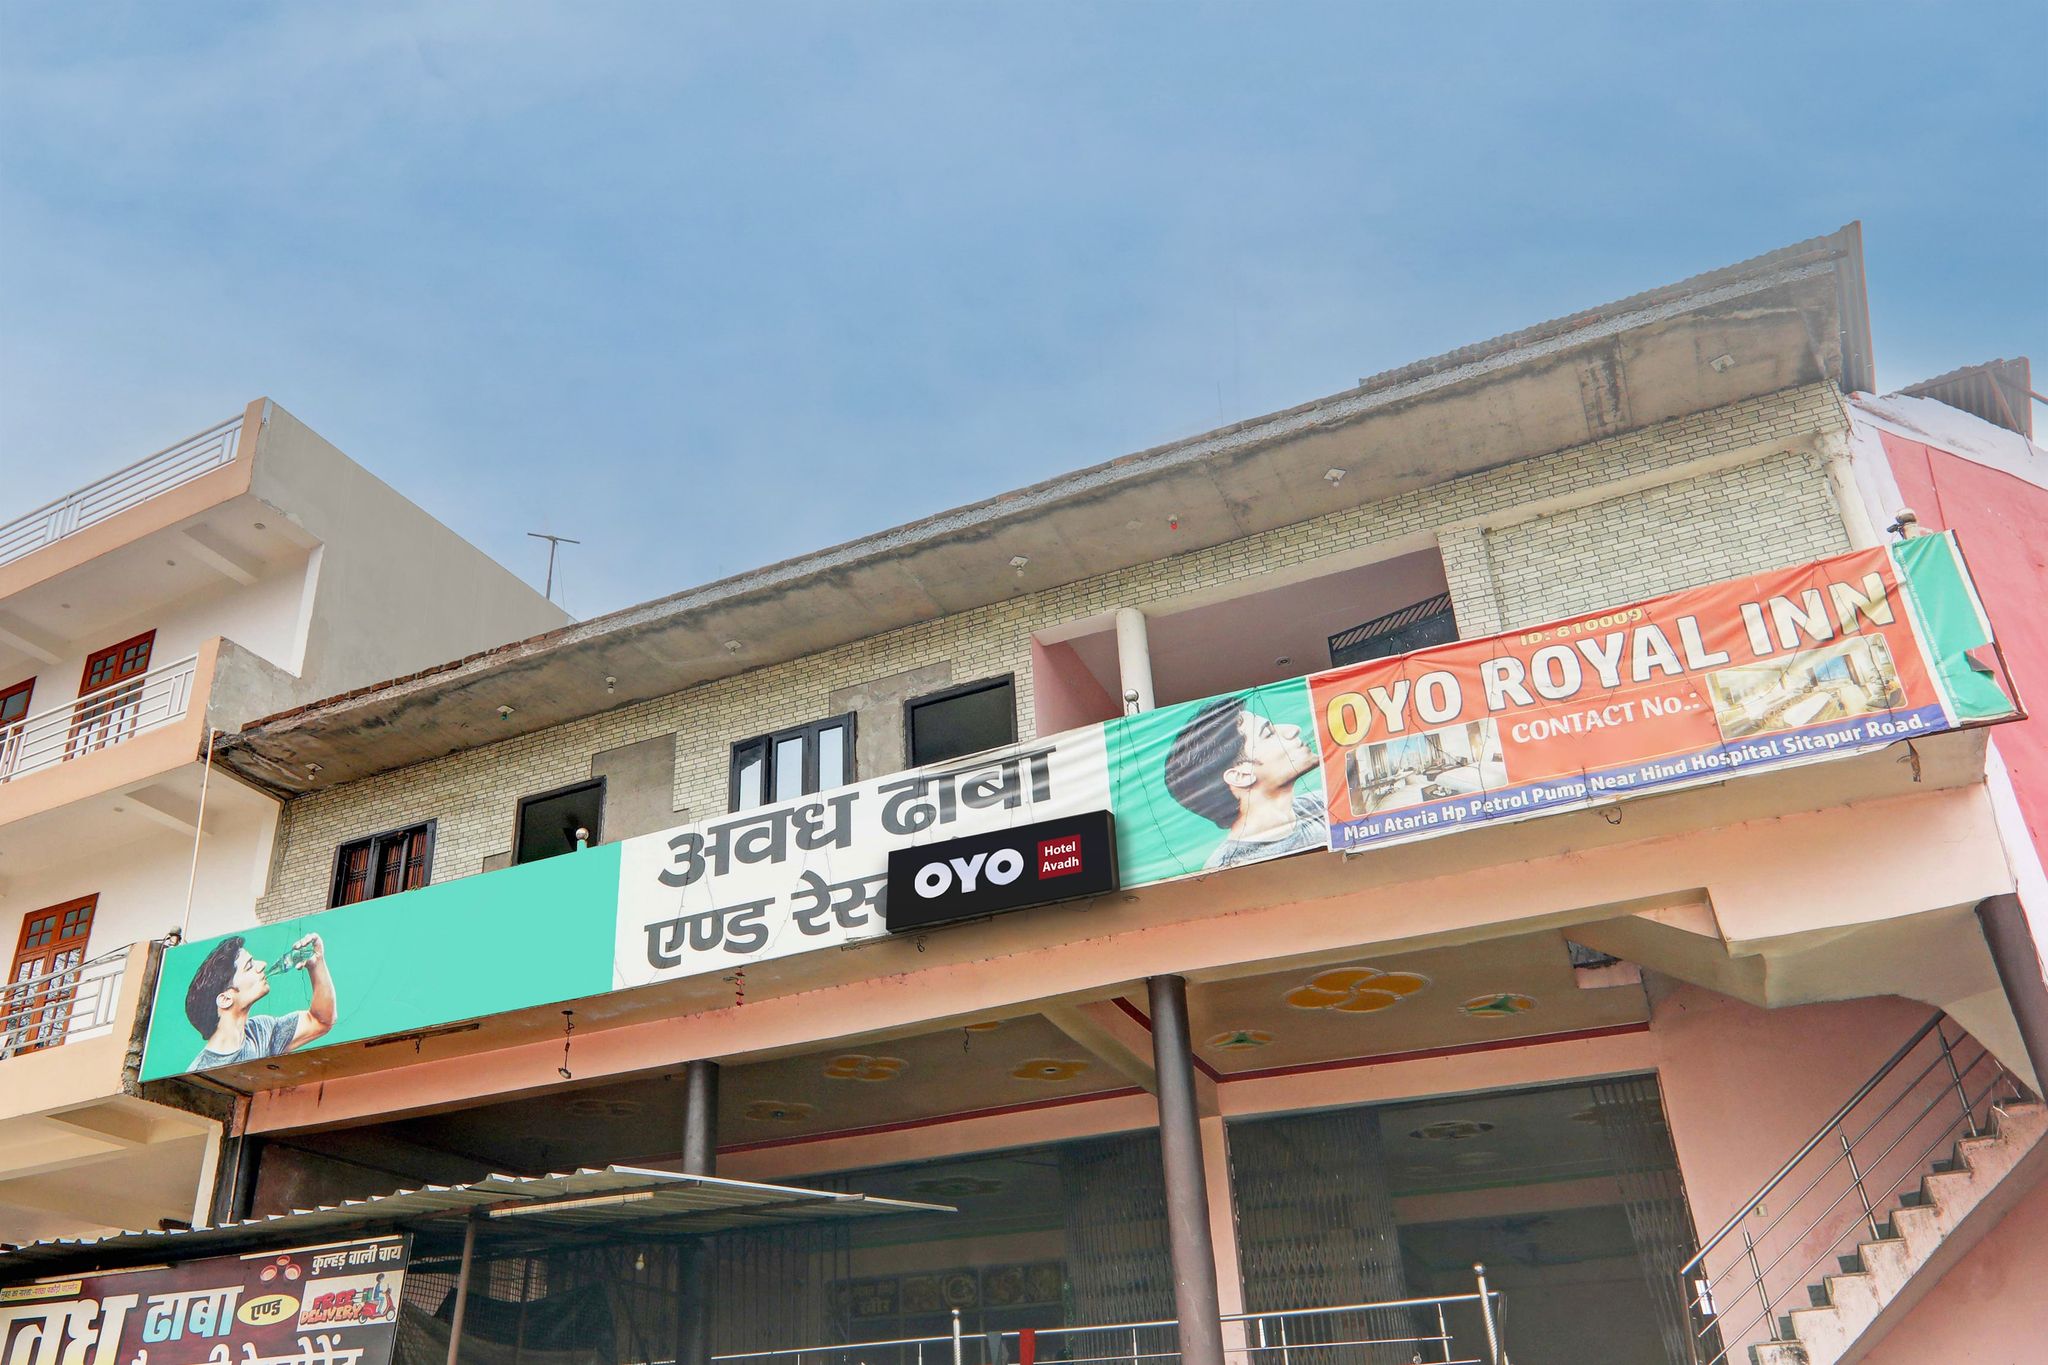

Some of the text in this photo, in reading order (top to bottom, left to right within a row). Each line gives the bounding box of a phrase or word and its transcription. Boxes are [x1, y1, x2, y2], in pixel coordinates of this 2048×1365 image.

[1327, 572, 1895, 746] OYO ROYAL INN
[1520, 632, 1551, 646] ID:
[1512, 701, 1635, 743] CONTACT
[1343, 713, 1931, 841] Mau Ataria Hp Petrol Pump Near Hind Hospital Sitapur Road.
[658, 745, 1057, 888] अवध ढाबा
[1042, 856, 1079, 873] Avadh
[1044, 841, 1076, 857] Hotel
[914, 848, 1024, 899] OYO
[644, 897, 775, 969] एण्ड
[348, 1244, 378, 1265] वाली
[379, 1245, 403, 1262] चाय
[142, 1284, 245, 1343] ढाबा
[300, 1304, 363, 1325] DELIVERY
[313, 1289, 357, 1311] FREE
